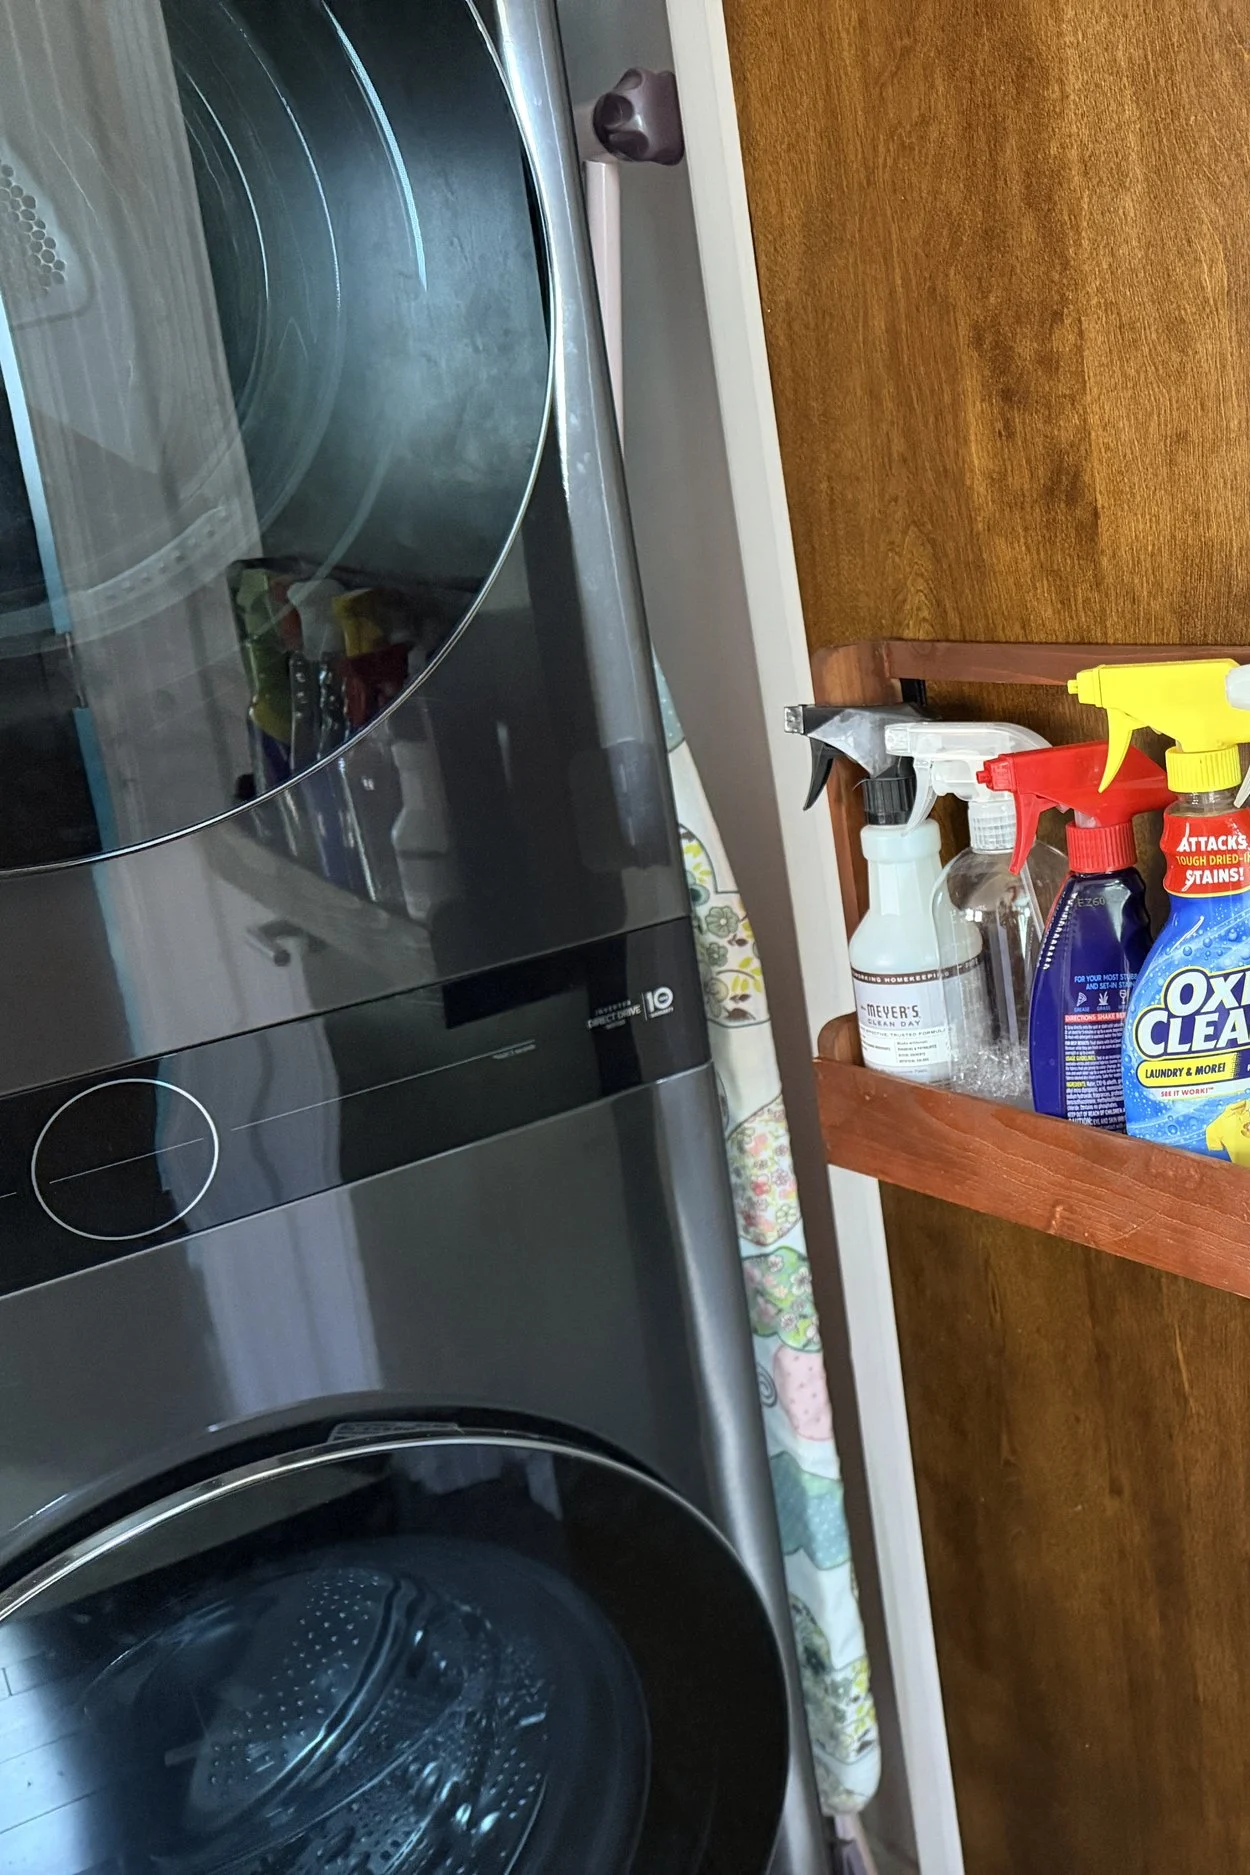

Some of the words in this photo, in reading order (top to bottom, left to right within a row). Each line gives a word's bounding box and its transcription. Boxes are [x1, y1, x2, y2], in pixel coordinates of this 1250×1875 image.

[1176, 832, 1248, 852] ATTACKS
[1176, 855, 1206, 866] TOUGH
[1185, 867, 1244, 886] STAINS!
[1086, 974, 1102, 982] YOUR
[867, 1003, 920, 1018] MEYER'S
[868, 1019, 895, 1027] CLEAN
[1145, 1066, 1183, 1079] LAUNDRY
[1185, 1066, 1193, 1076] &
